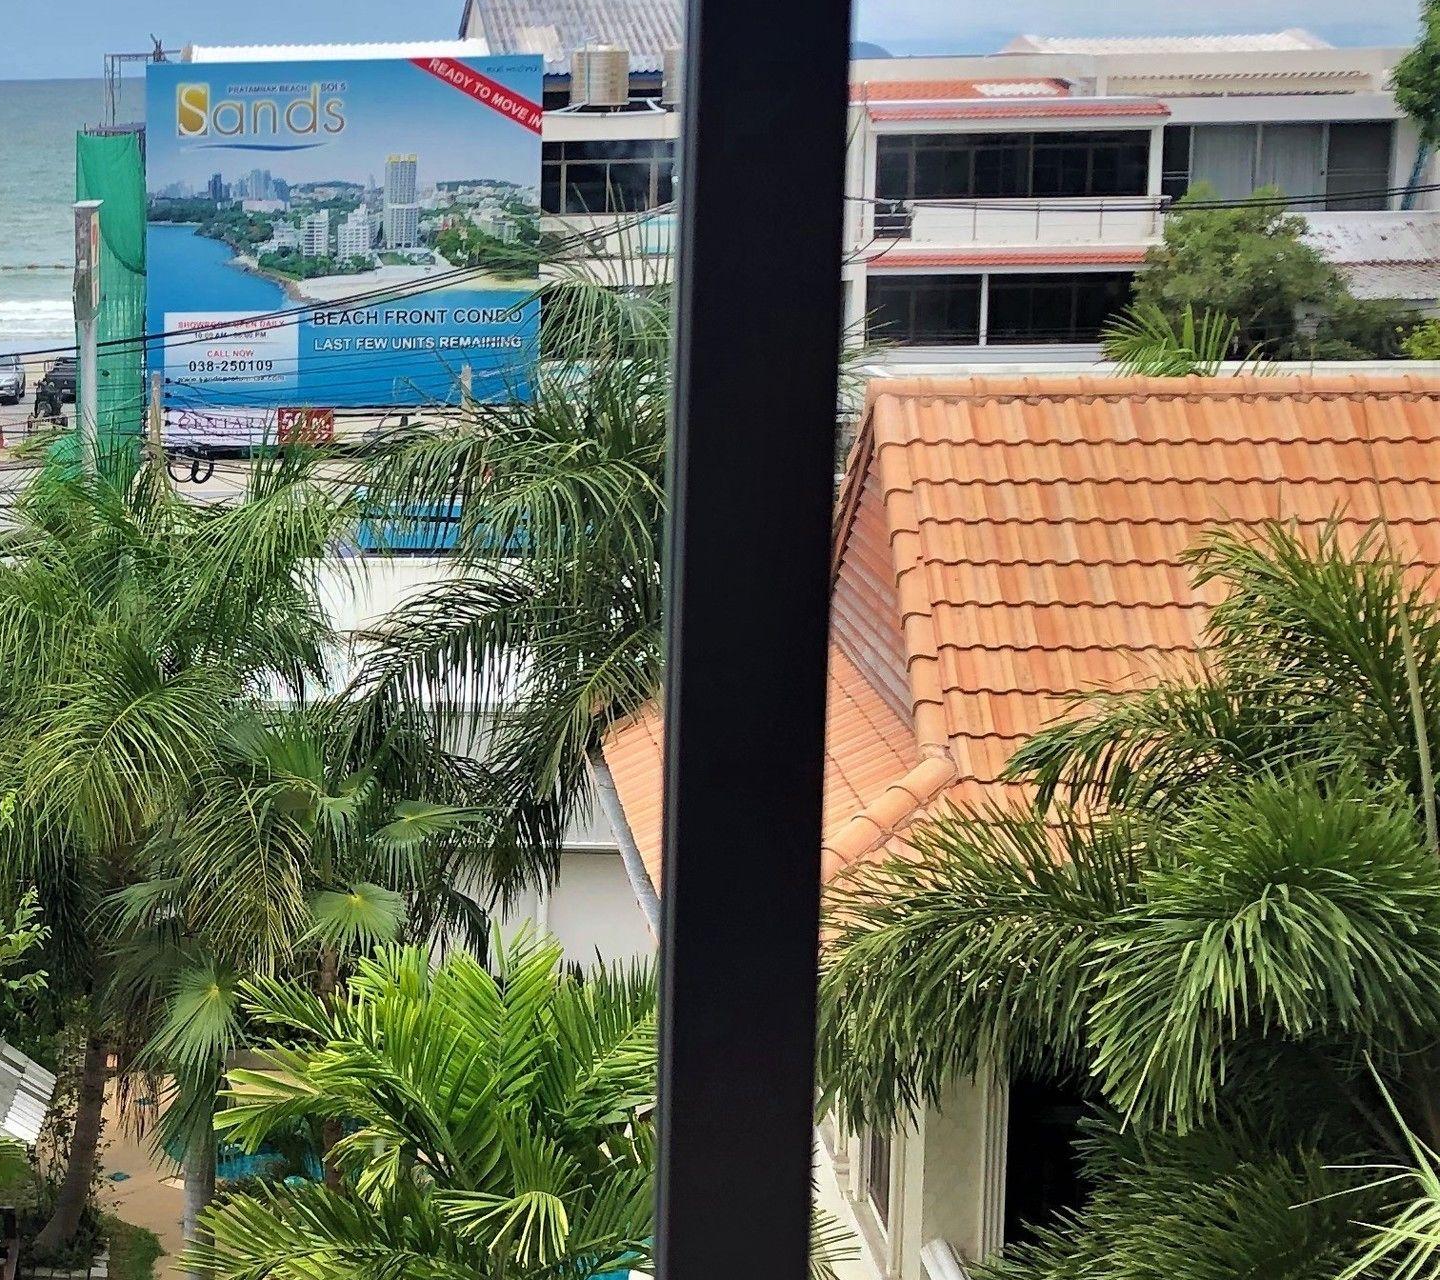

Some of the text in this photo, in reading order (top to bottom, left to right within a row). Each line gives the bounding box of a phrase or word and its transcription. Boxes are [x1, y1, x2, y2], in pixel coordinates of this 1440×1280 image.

[428, 58, 474, 89] READY
[472, 81, 492, 99] TO
[491, 91, 530, 121] MOVE
[178, 83, 346, 136] Sands
[313, 308, 523, 326] BEACH FRONT CONDO
[314, 335, 522, 351] LAST FEW UNITS REMAINING
[232, 349, 255, 357] NOW
[188, 359, 274, 372] 038-250109
